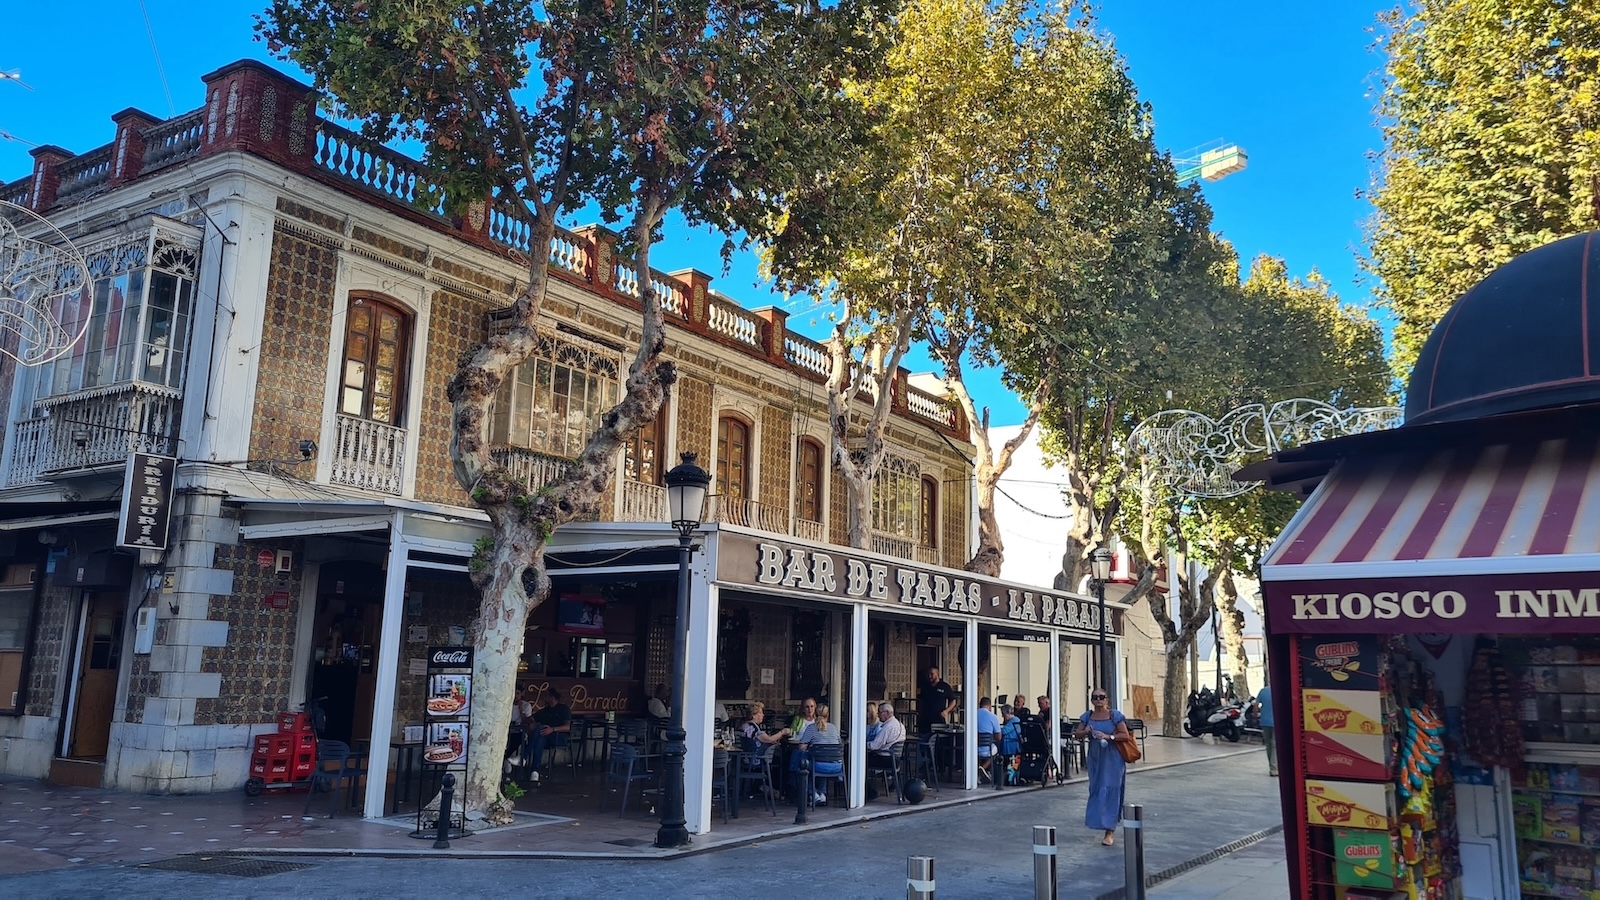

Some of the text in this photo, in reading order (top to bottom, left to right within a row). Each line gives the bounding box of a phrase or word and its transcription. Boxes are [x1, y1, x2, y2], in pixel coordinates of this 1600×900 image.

[759, 543, 837, 593] BAR
[847, 559, 888, 600] DE
[897, 568, 982, 614] TAPAS
[1008, 589, 1038, 622] LA
[1041, 594, 1115, 634] PARADA
[1291, 588, 1600, 620] KIOSCO INM
[570, 684, 628, 710] Parada
